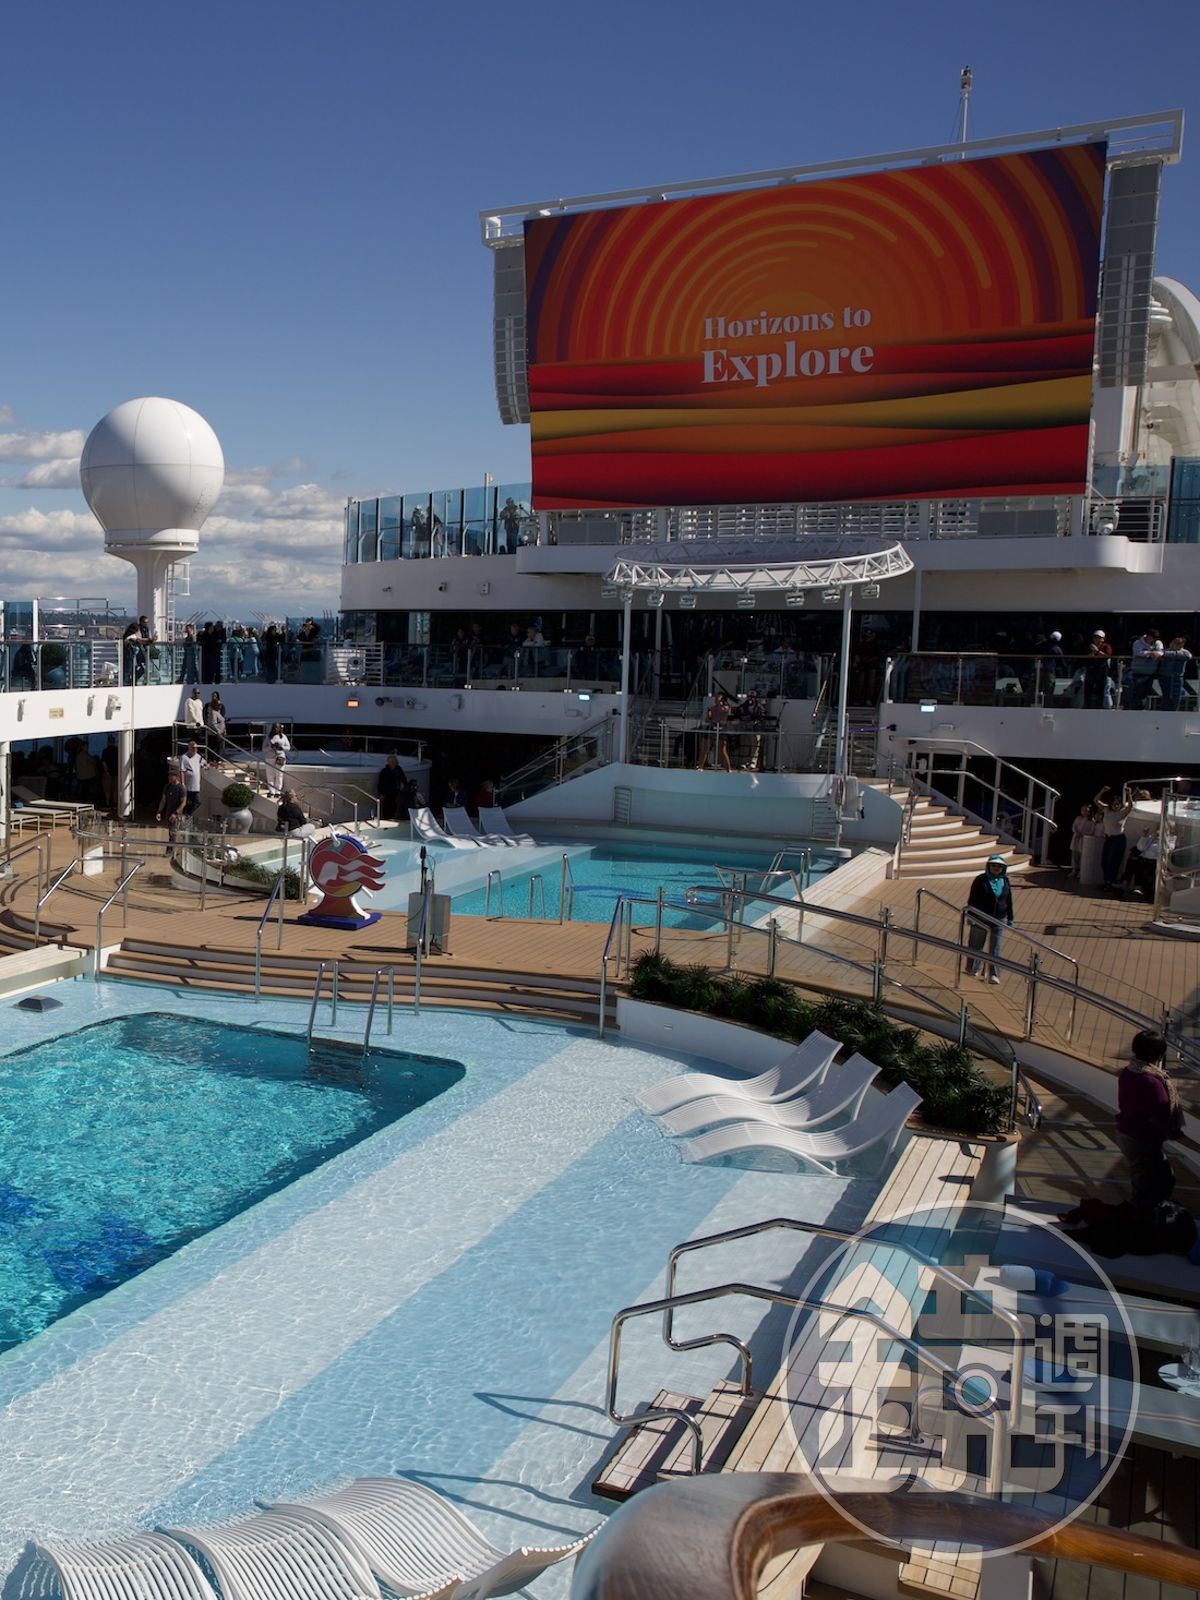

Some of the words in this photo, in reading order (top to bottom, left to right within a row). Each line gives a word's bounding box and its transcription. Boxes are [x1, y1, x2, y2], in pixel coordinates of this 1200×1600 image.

[704, 310, 834, 340] Horizons
[842, 306, 872, 328] to
[702, 340, 875, 387] Explore
